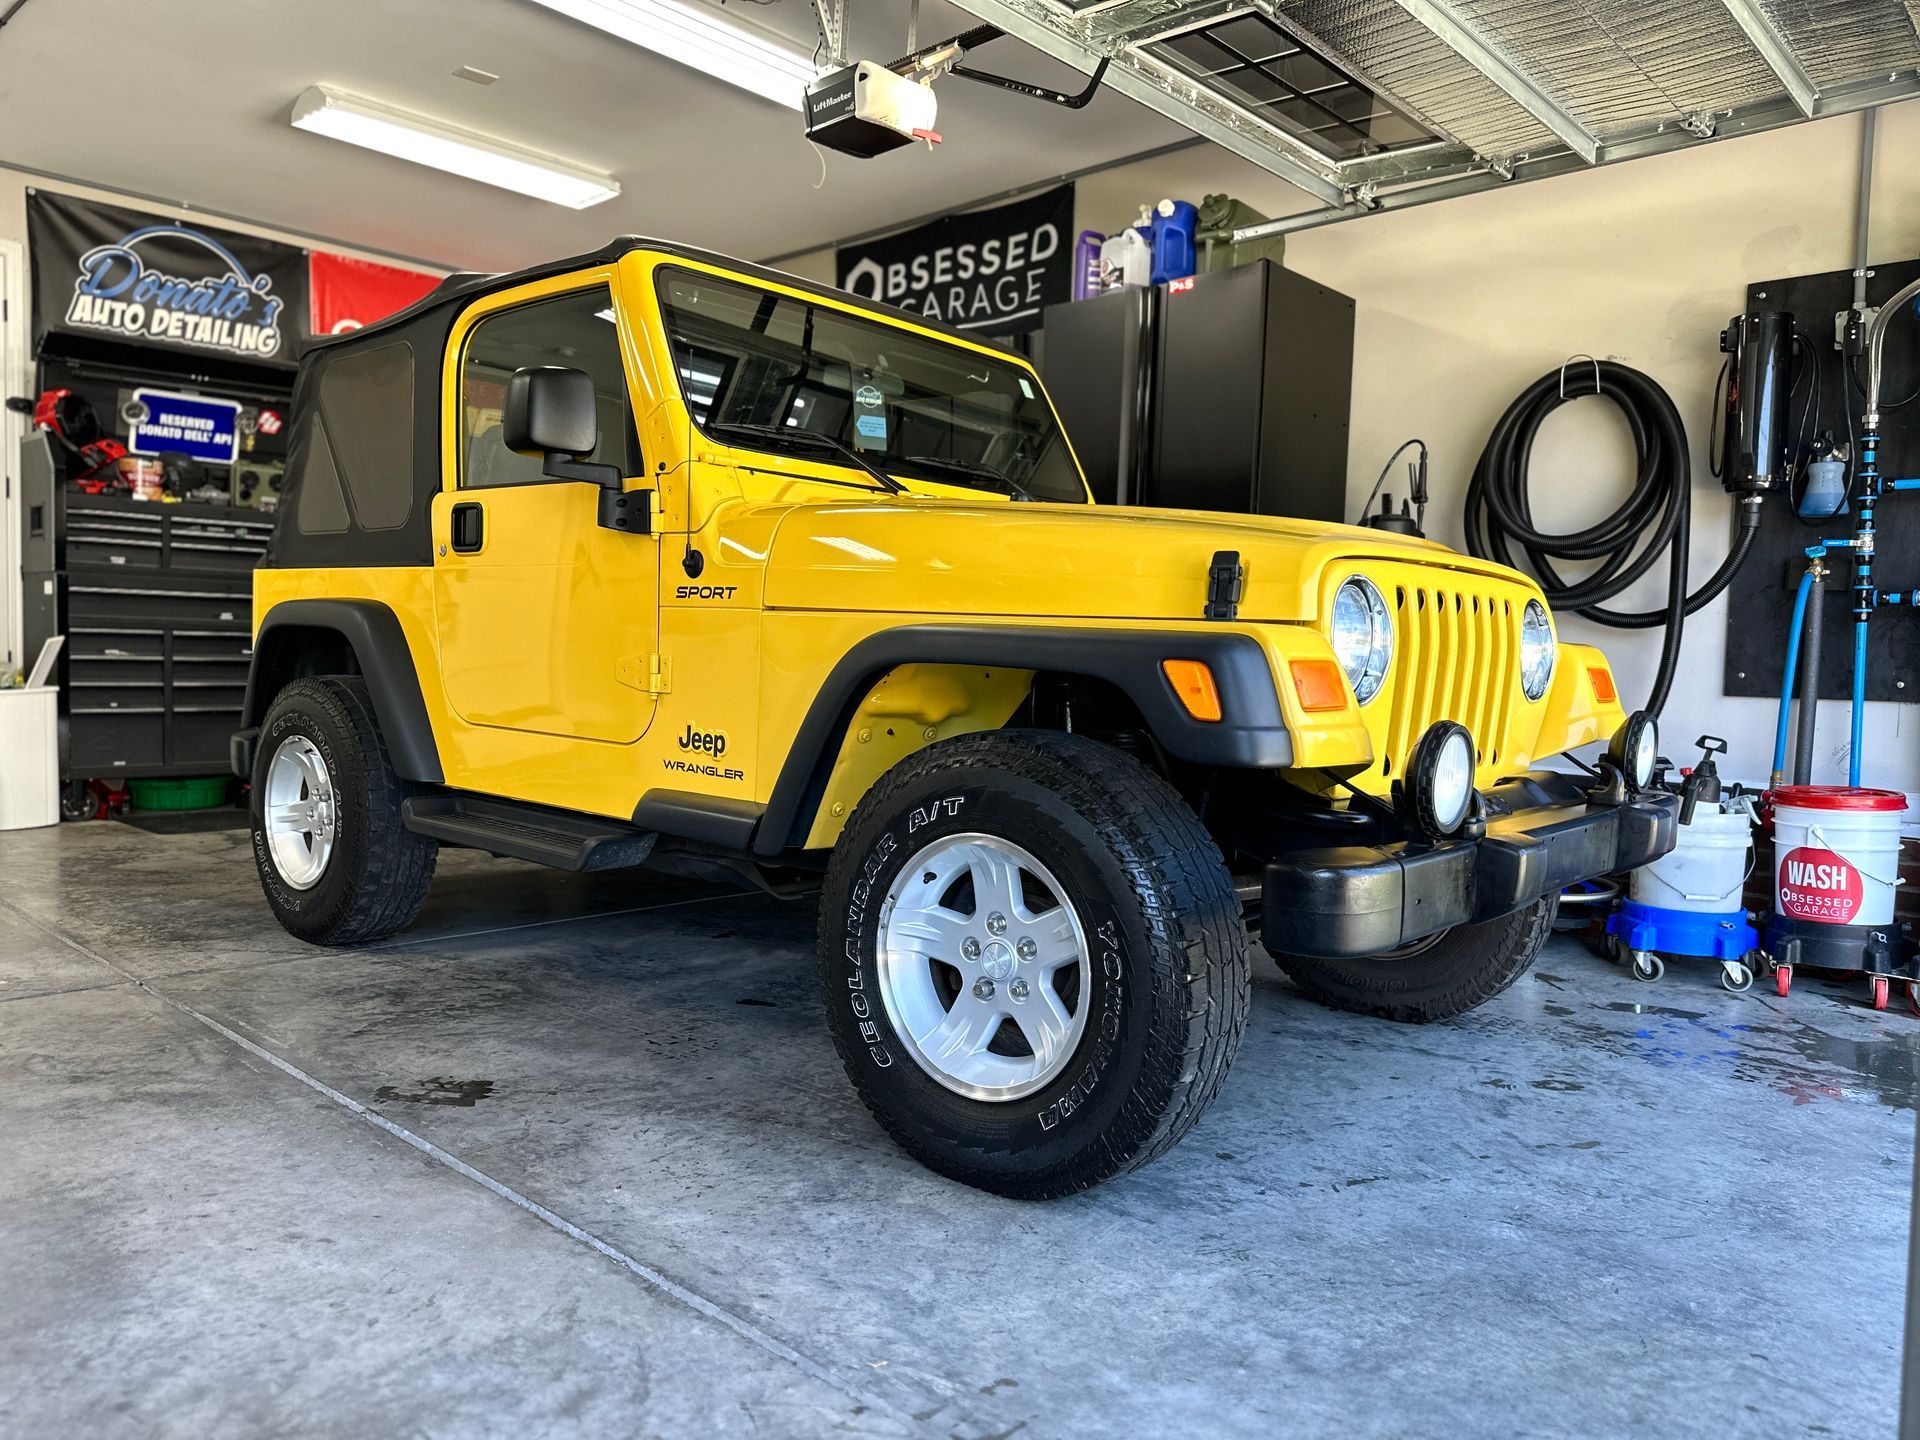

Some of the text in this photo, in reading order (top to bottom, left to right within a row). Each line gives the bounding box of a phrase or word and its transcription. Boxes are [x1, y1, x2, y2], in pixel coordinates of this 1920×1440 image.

[813, 92, 852, 113] LiftMaster
[845, 223, 1059, 302] OBSESSED
[80, 249, 278, 326] Donato's
[1168, 278, 1194, 293] P&S
[71, 294, 276, 352] AUTO DETAILING
[138, 424, 183, 440] DONATO
[184, 430, 213, 443] DELL'
[160, 413, 215, 431] RESERVED
[676, 586, 737, 599] SPORT
[679, 725, 726, 758] Jeep
[663, 759, 744, 781] WRANGLER
[909, 796, 964, 833] A/T
[1788, 860, 1847, 891] WASH
[1781, 887, 1853, 908] OBSESSED
[1793, 902, 1849, 917] GARAGE
[845, 832, 898, 1067] GEOLANDAR
[1038, 920, 1123, 1131] YOKOHAMA
